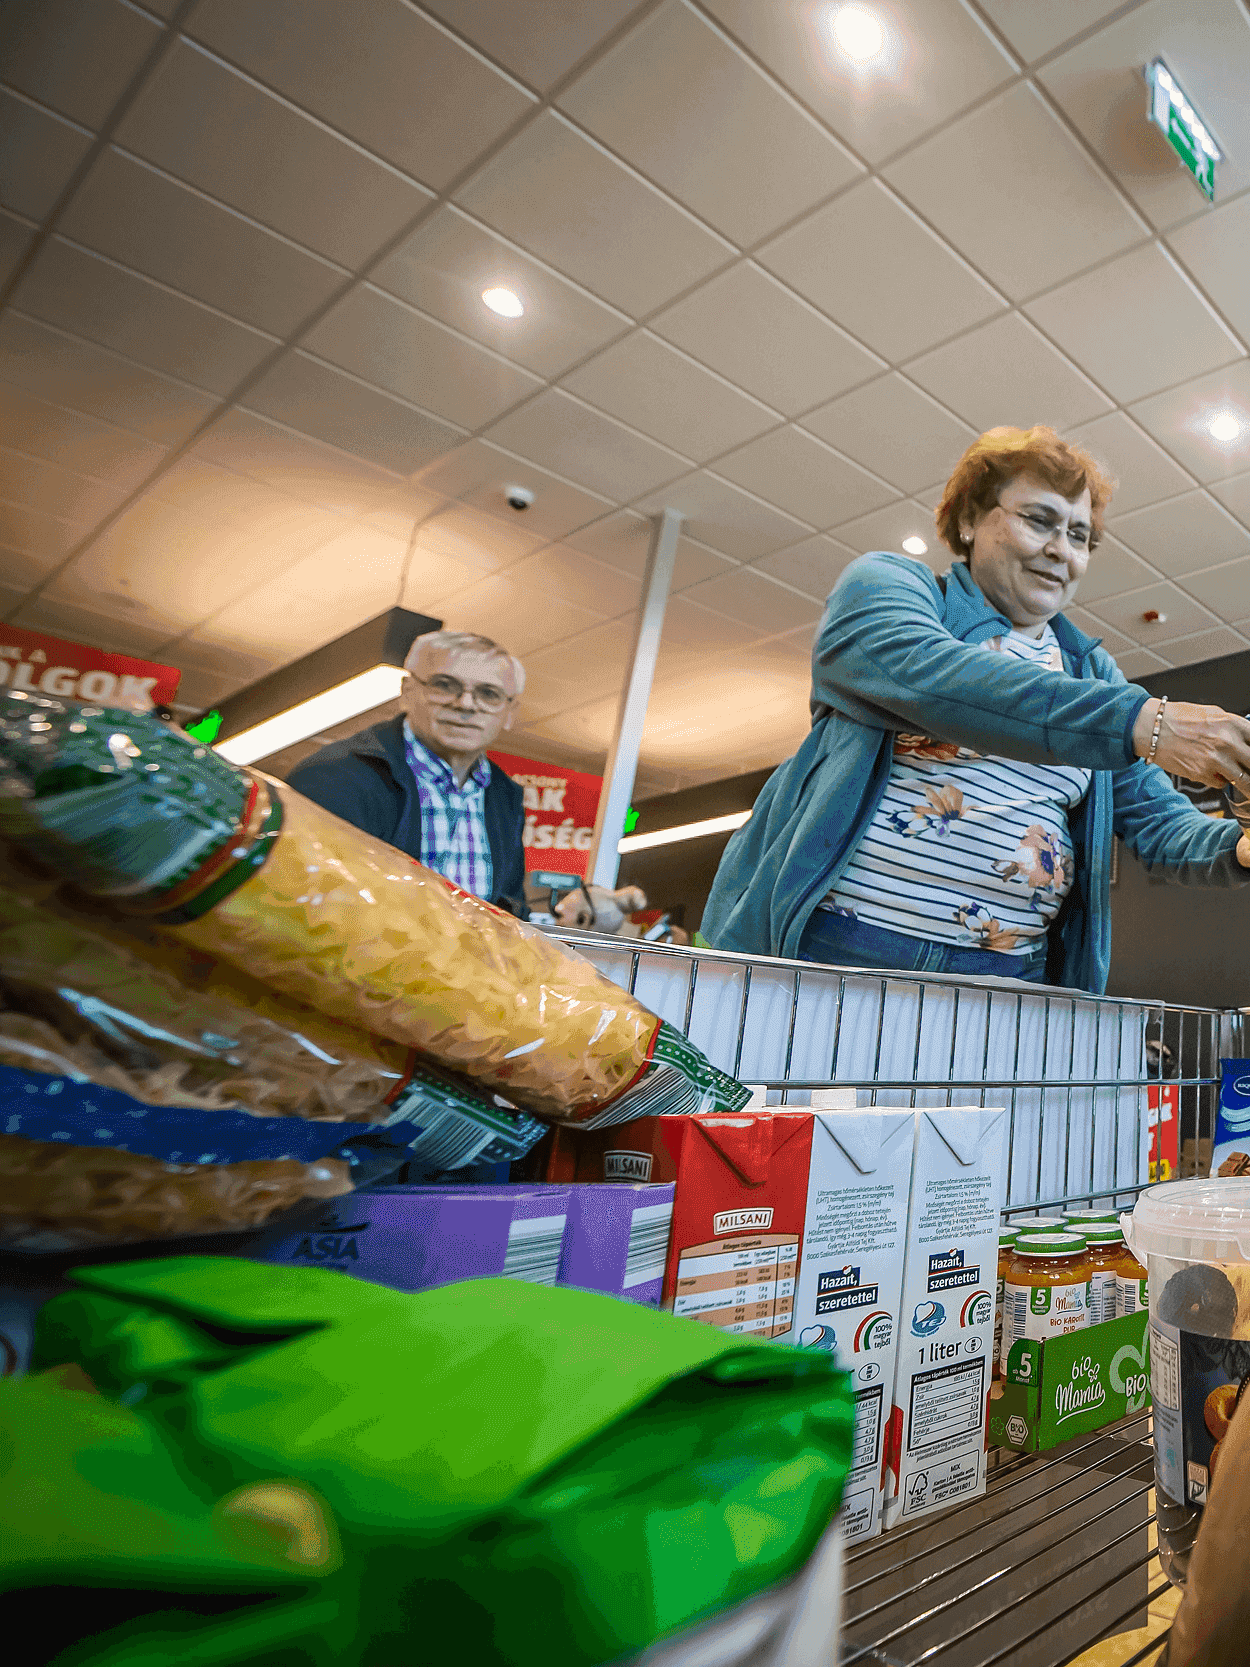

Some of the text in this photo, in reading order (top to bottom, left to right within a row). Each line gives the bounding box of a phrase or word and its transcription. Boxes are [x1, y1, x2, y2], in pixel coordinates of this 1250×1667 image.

[718, 1213, 768, 1229] MILSANI
[293, 1237, 358, 1260] ASIA
[931, 1257, 962, 1270] Hazait,
[821, 1276, 857, 1290] Hazait,
[930, 1271, 978, 1289] szeretettel
[818, 1290, 876, 1311] szeretettel
[1036, 1289, 1046, 1305] 5
[875, 1324, 892, 1332] 100%
[1050, 1318, 1062, 1326] BiO
[873, 1332, 892, 1340] magyar
[919, 1348, 925, 1364] 1
[930, 1341, 962, 1362] liter
[1072, 1356, 1091, 1380] bio
[1125, 1374, 1147, 1397] BiO
[1055, 1381, 1105, 1416] Mamia
[910, 1494, 927, 1505] FSC
